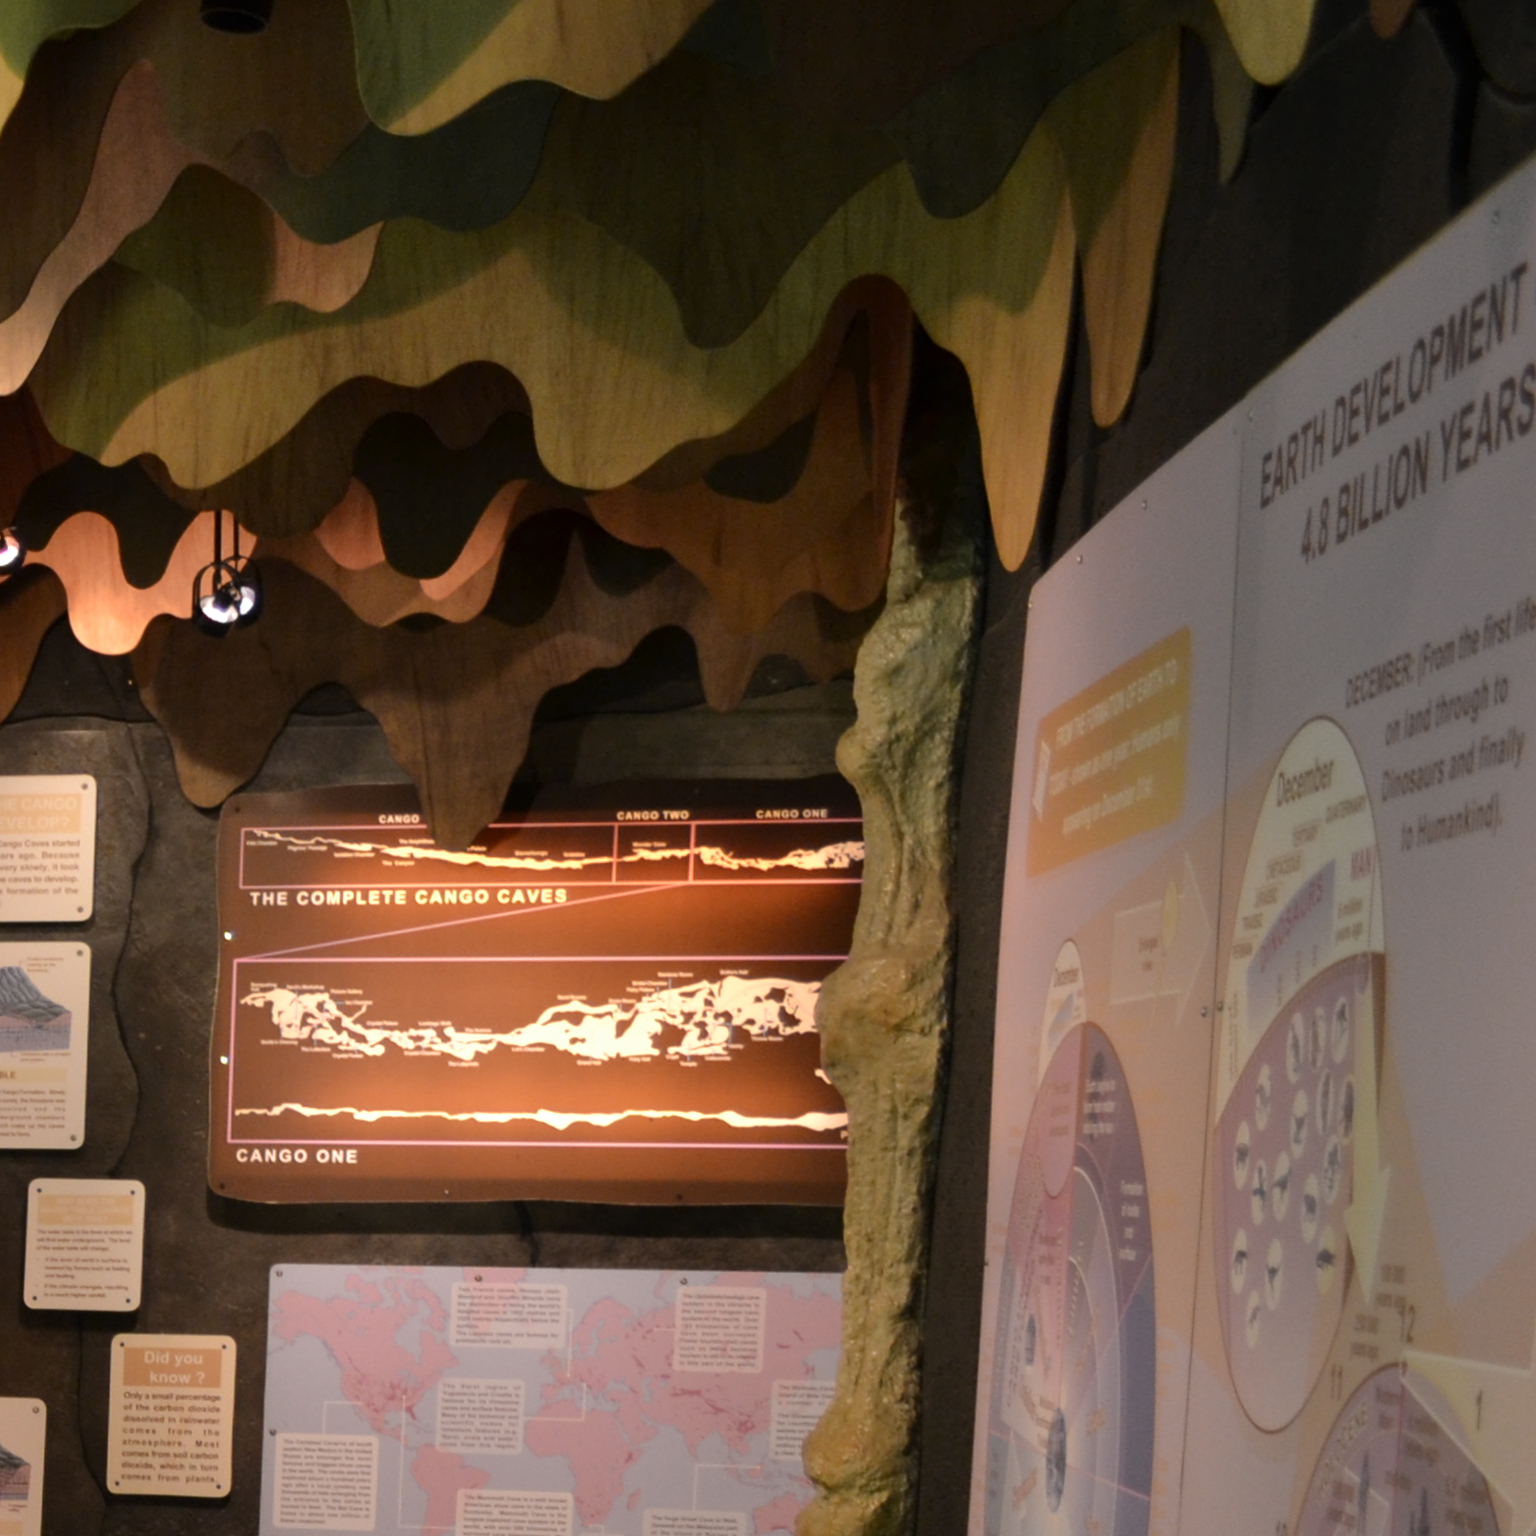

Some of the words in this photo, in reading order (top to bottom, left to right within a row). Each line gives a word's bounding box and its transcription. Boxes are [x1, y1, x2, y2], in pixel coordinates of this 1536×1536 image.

[1260, 408, 1327, 510] EARTH
[1331, 260, 1528, 458] DEVELOPMENT
[1301, 496, 1329, 565] 4.8
[1336, 429, 1430, 545] BILLION
[1440, 362, 1536, 483] YEARS
[21, 796, 77, 810] CANGO
[378, 814, 420, 824] CANGO
[617, 811, 660, 821] CANGO
[663, 810, 690, 821] TWO
[756, 809, 800, 819] CANGO
[802, 809, 828, 819] ONE
[250, 892, 288, 906] THE
[296, 890, 407, 906] COMPLETE
[415, 889, 489, 905] CANGO
[497, 889, 567, 904] CAVES
[236, 1149, 308, 1163] CANGO
[316, 1149, 358, 1163] ONE
[144, 1351, 170, 1363] Did
[175, 1355, 203, 1367] you
[150, 1371, 191, 1383] know
[196, 1372, 205, 1384] ?
